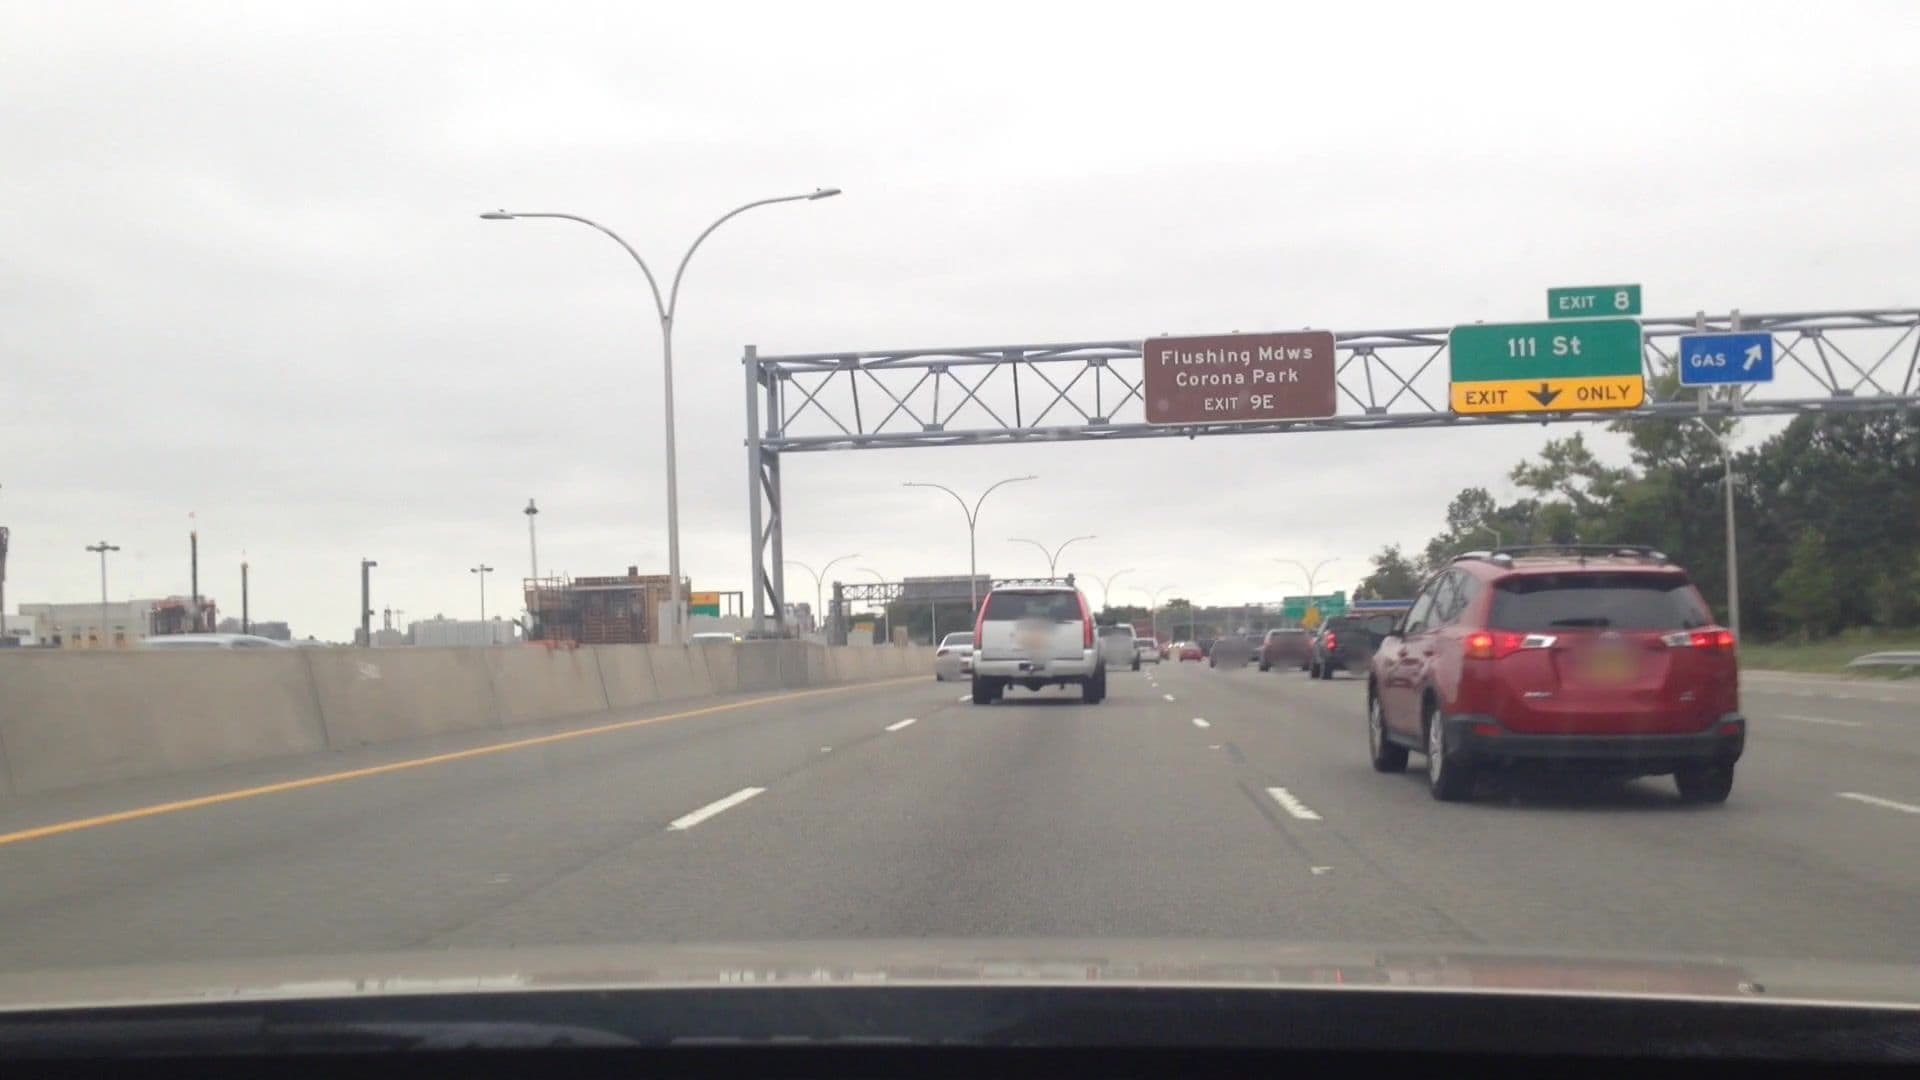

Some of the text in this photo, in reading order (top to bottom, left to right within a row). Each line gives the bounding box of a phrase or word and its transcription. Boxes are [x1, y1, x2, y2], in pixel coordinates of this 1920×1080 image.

[1559, 291, 1630, 310] EXIT 8
[1161, 346, 1313, 366] Flushing Mdws
[1507, 336, 1582, 358] 111 St
[1690, 352, 1726, 367] GAS
[1176, 368, 1299, 387] Corona Park
[1204, 394, 1275, 411] EXIT 9E
[1465, 385, 1631, 406] EXIT ONLY
